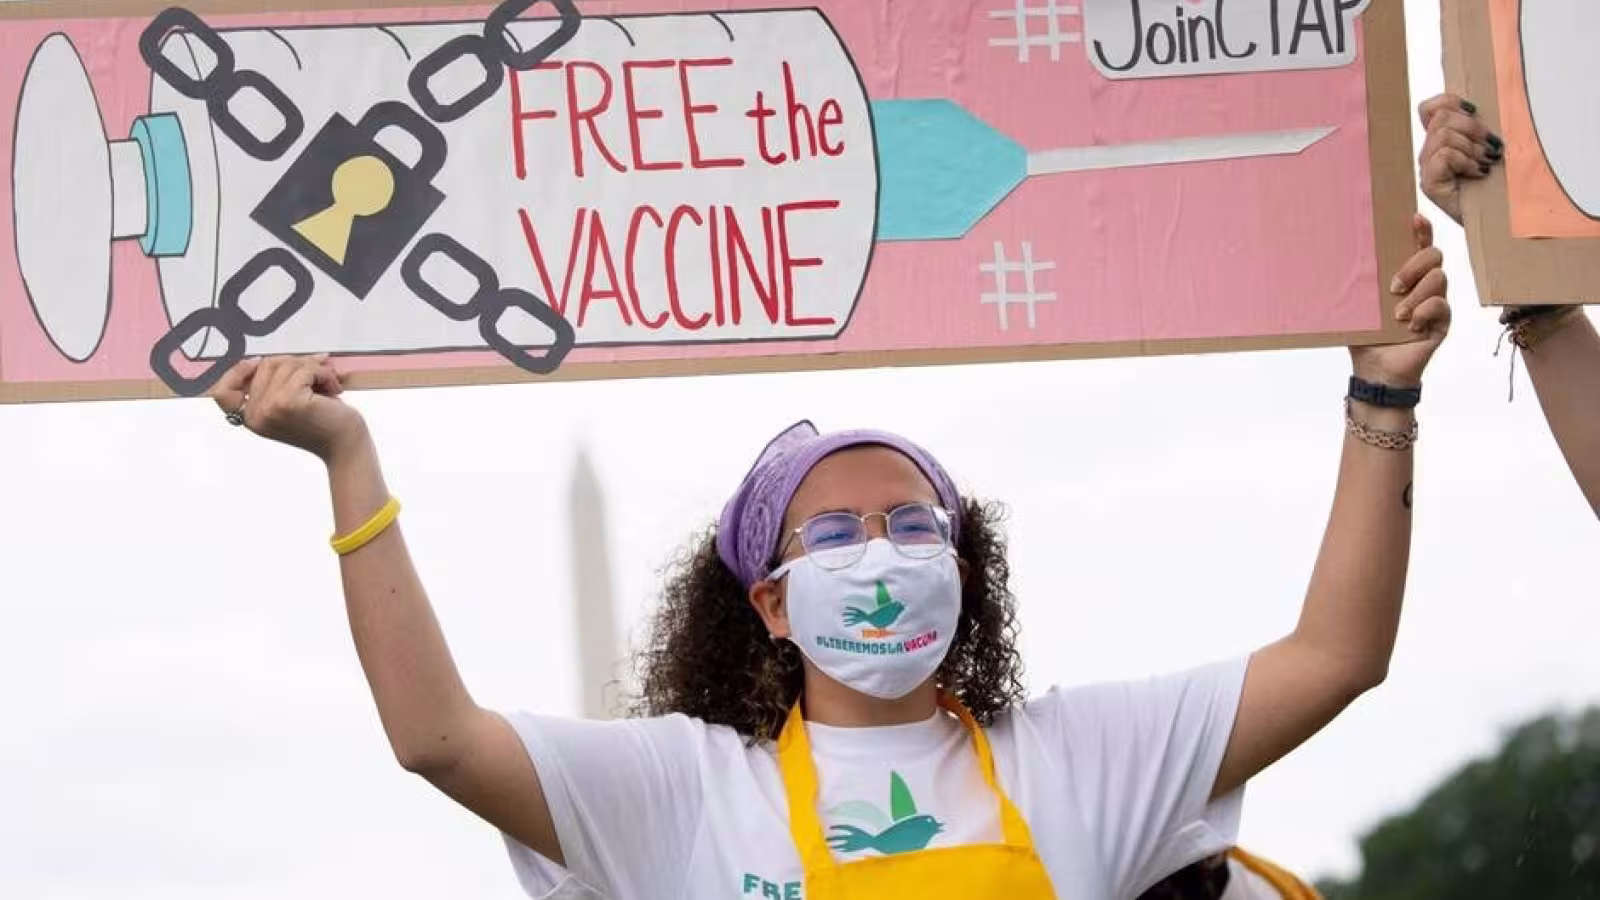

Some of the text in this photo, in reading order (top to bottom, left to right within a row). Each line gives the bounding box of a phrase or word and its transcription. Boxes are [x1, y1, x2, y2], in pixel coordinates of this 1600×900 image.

[509, 58, 845, 179] FREE the
[519, 200, 840, 329] VACCINE
